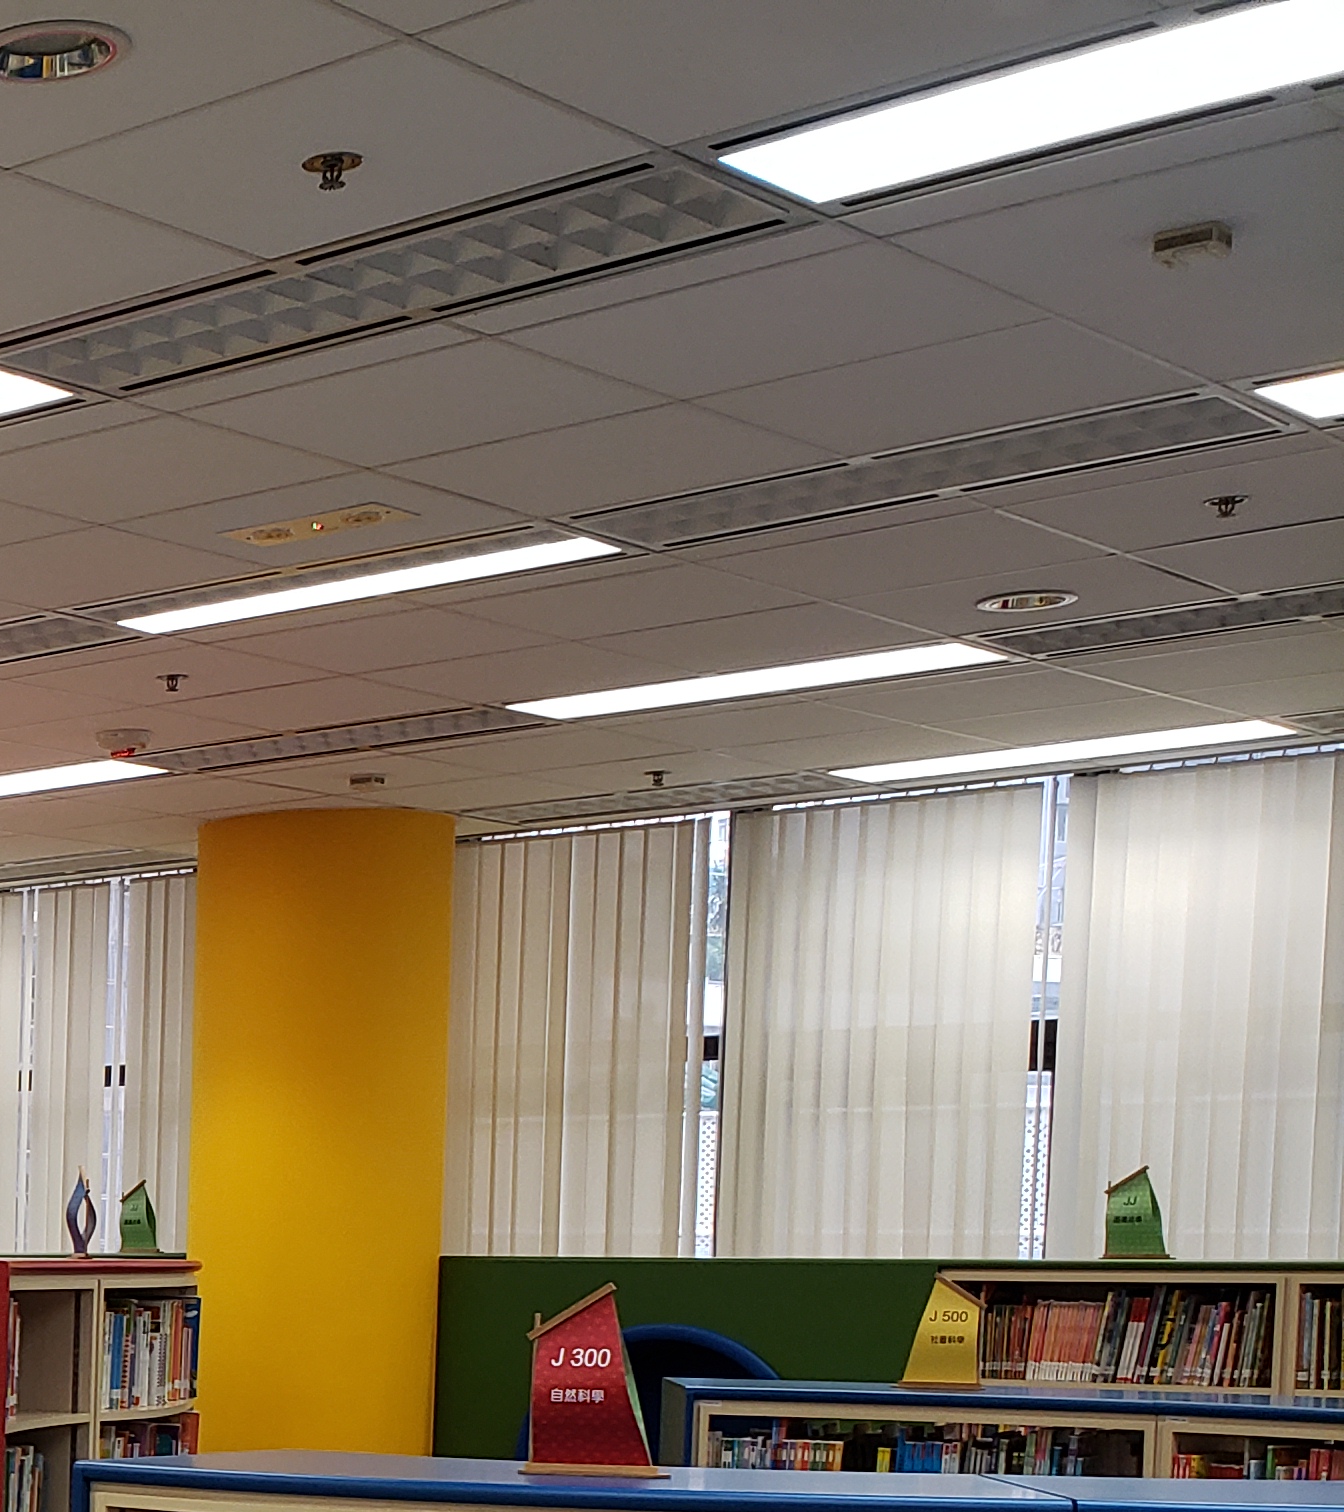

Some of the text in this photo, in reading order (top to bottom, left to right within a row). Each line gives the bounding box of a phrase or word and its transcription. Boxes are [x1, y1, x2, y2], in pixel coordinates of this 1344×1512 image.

[1123, 1196, 1137, 1206] JJ
[928, 1310, 969, 1322] J 500
[551, 1347, 611, 1368] J 300
[550, 1387, 605, 1404] 自然科學
